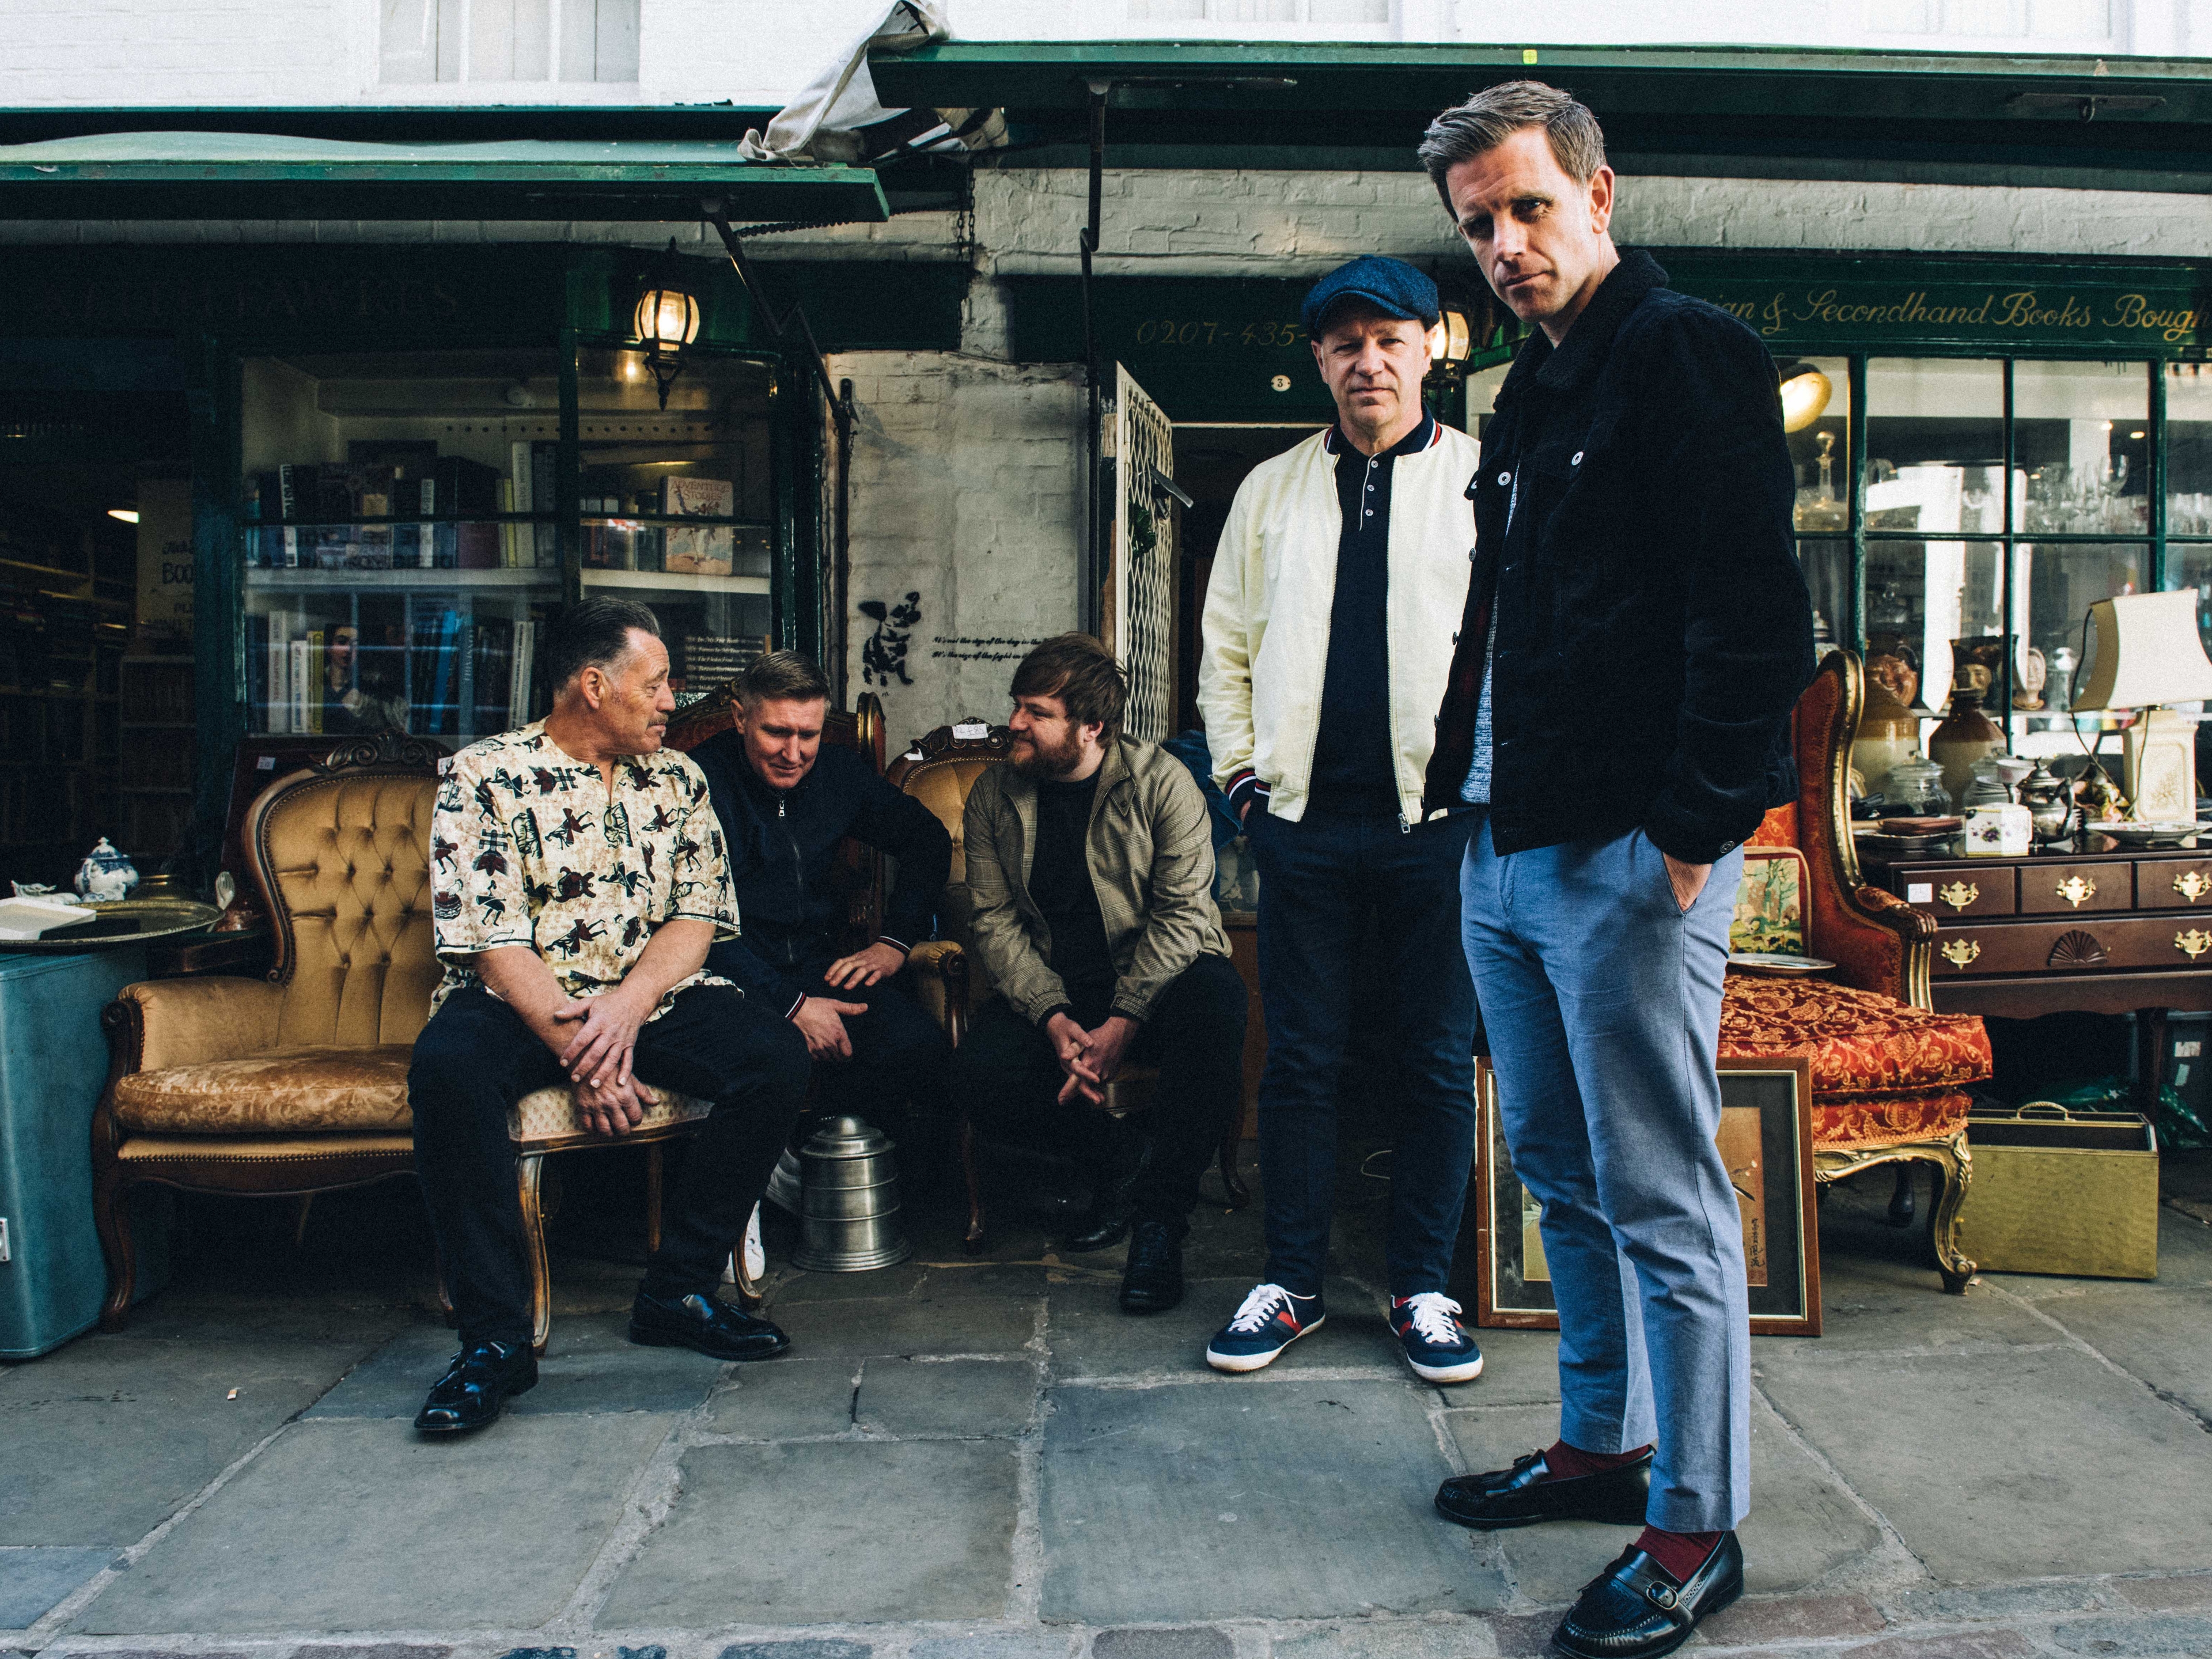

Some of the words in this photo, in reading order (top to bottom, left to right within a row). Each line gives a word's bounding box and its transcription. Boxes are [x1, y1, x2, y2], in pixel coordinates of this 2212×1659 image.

[236, 281, 459, 319] FAWKES
[1761, 291, 1789, 335] &
[1793, 289, 1993, 325] Secondhand
[1992, 290, 2092, 328] Books
[1277, 378, 1283, 388] 3
[986, 637, 995, 646] of
[972, 652, 982, 661] of
[991, 652, 1012, 662] fight
[967, 726, 984, 737] £85
